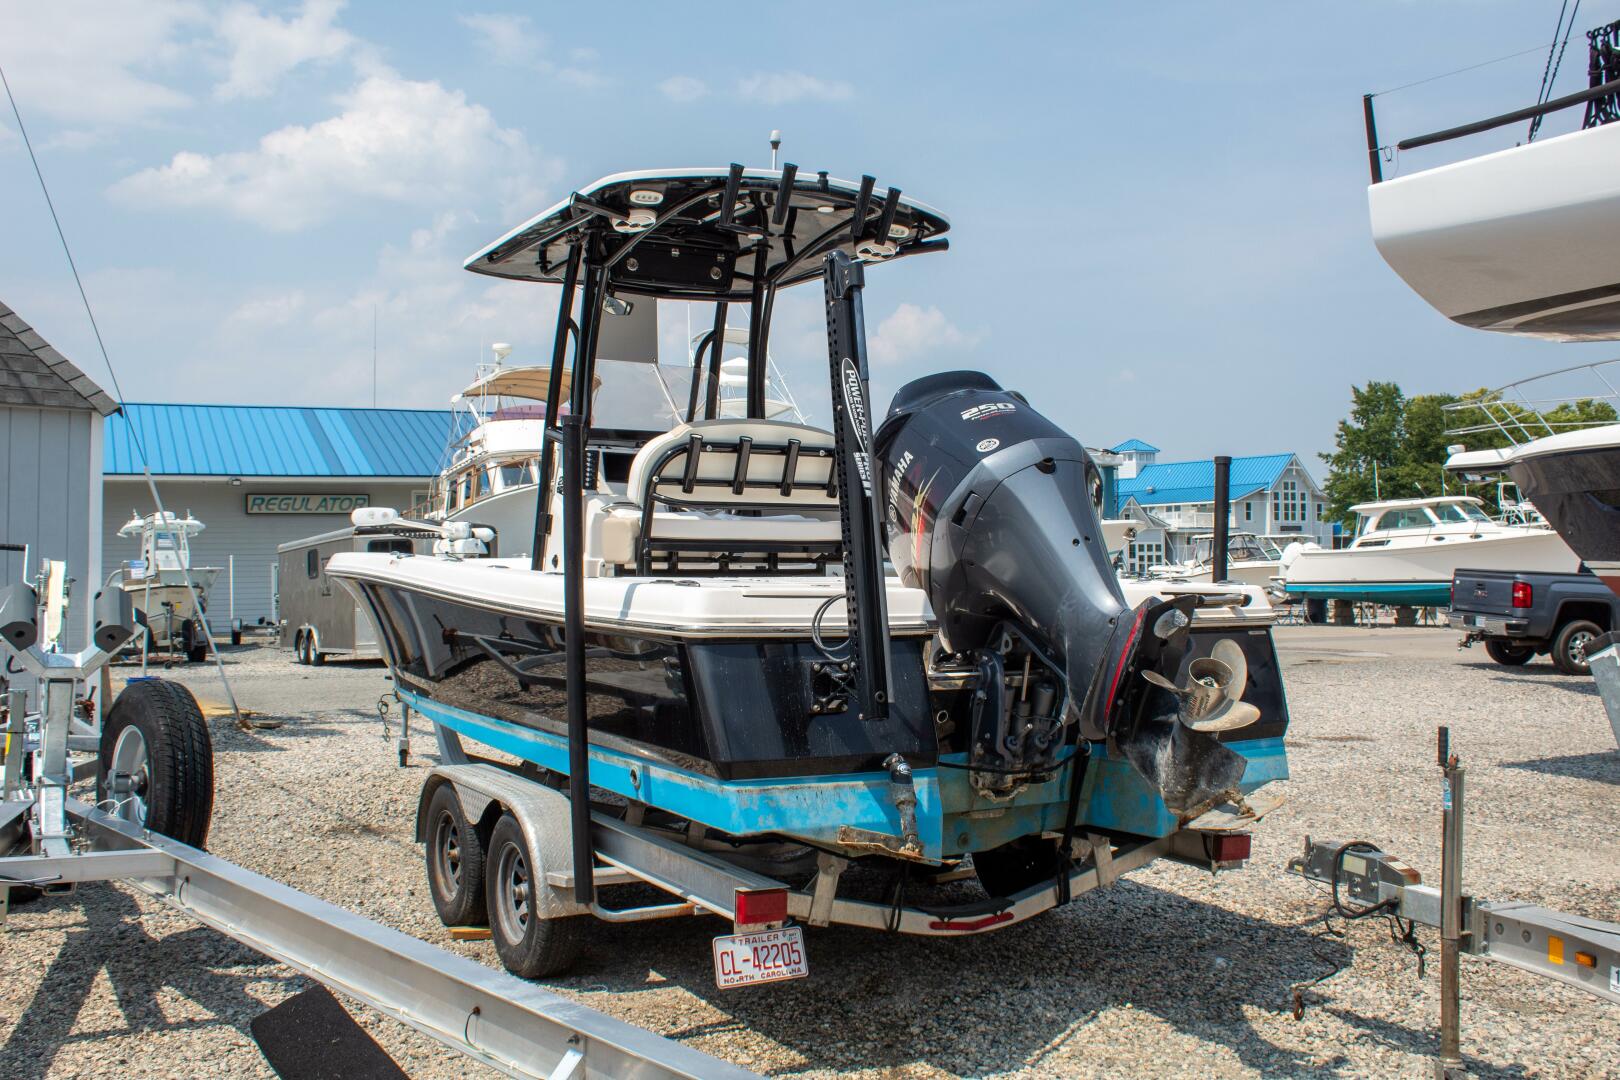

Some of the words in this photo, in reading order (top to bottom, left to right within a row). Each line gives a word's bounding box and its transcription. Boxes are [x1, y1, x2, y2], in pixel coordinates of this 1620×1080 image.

[960, 402, 1016, 420] 250
[889, 450, 914, 508] YAMAHA
[250, 497, 367, 511] REGULATOR
[738, 934, 778, 945] TRAILER
[720, 941, 801, 976] CL-42205
[724, 974, 755, 984] NORTH
[760, 967, 801, 979] CAROLINA
